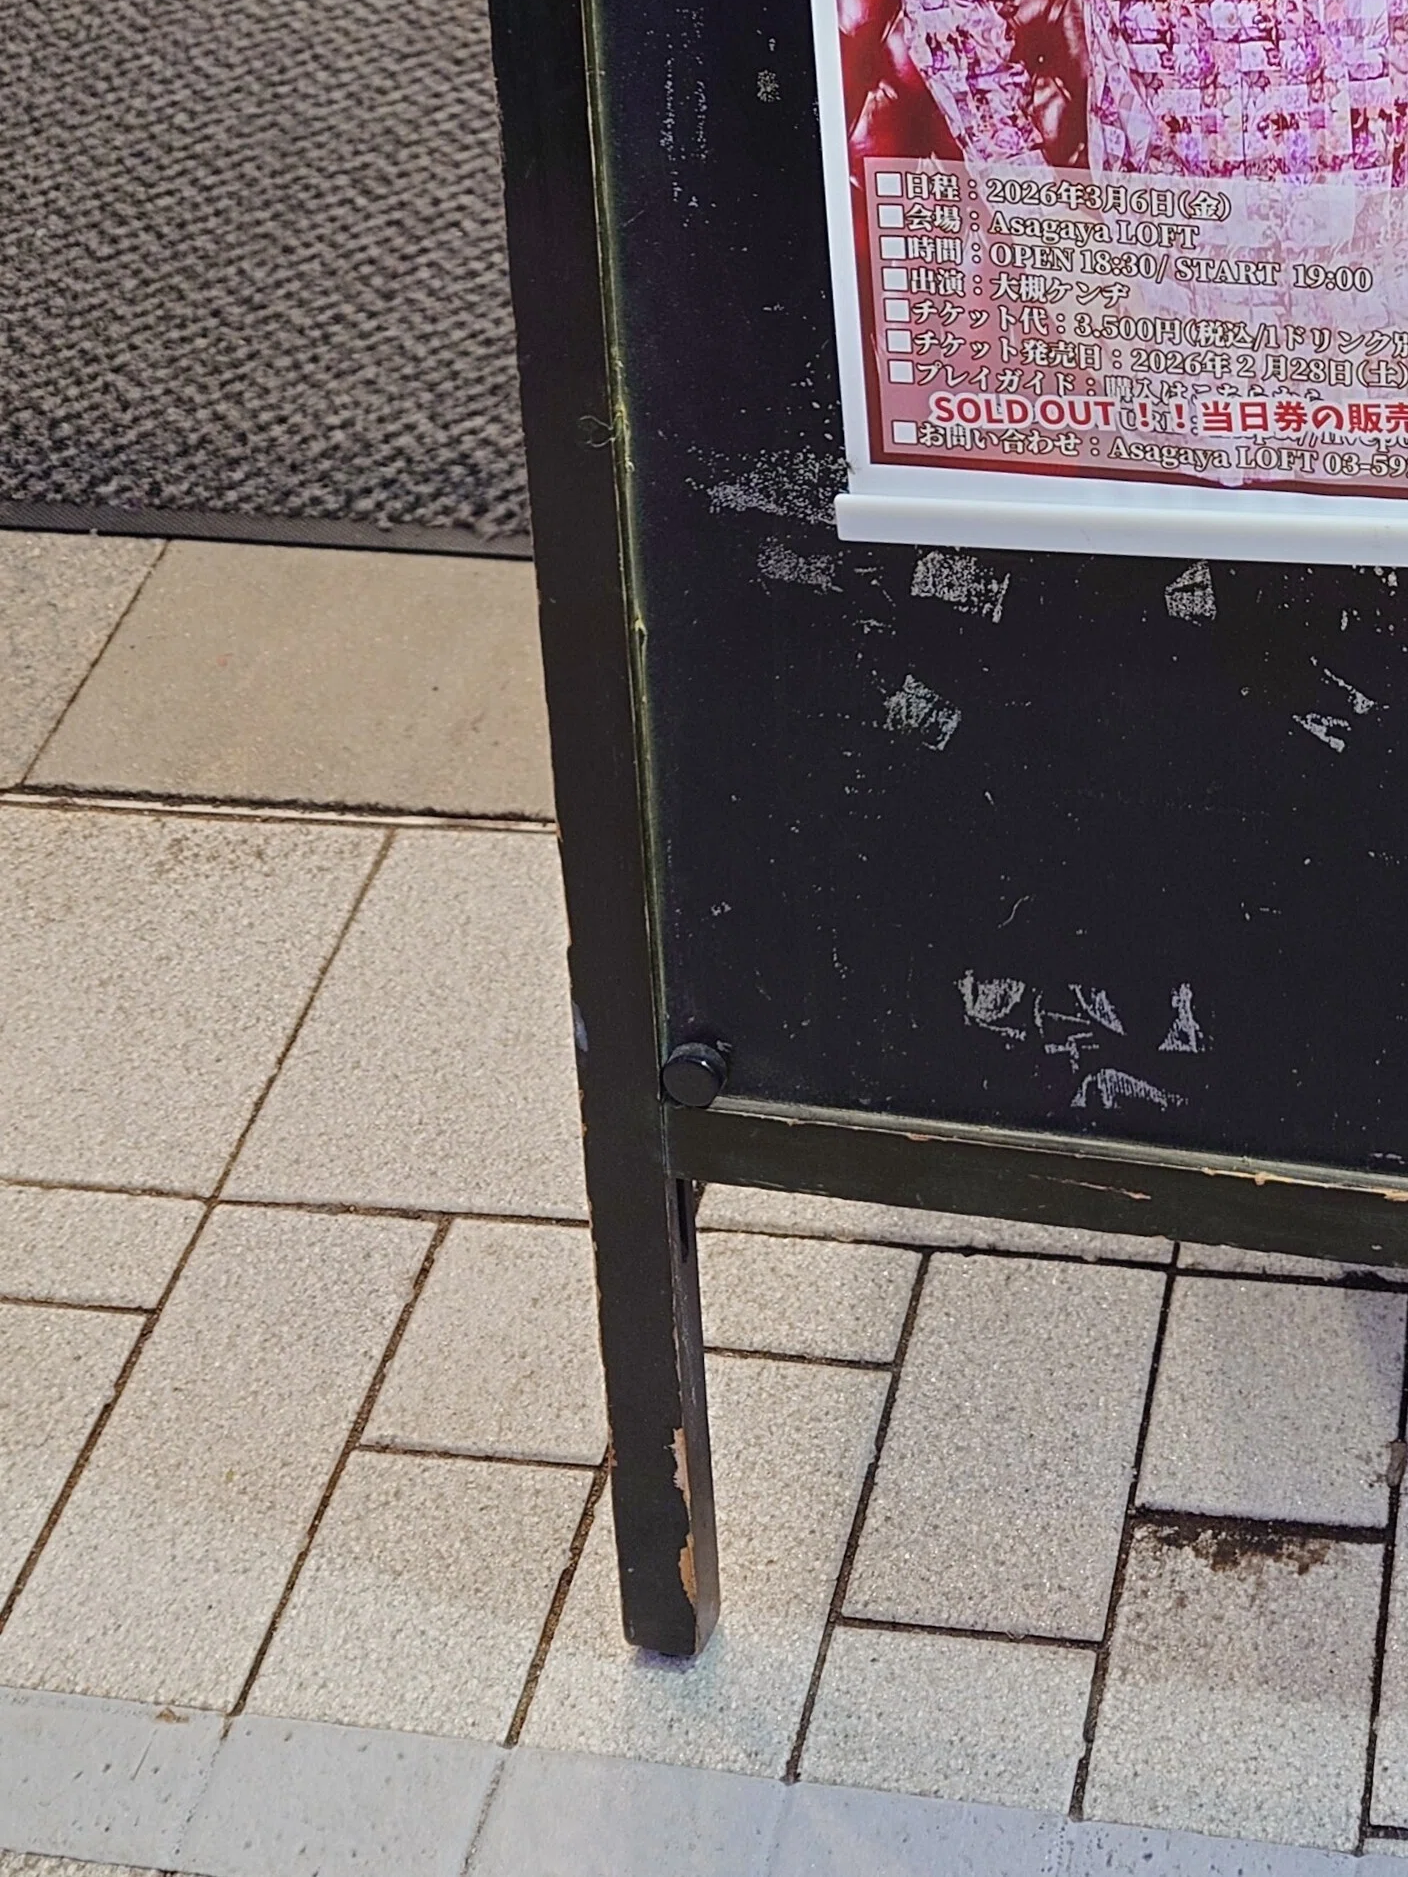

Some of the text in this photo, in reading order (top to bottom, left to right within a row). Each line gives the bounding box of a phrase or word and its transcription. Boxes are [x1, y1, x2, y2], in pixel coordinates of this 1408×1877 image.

[1117, 219, 1200, 250] LOFT
[1174, 256, 1281, 286] START
[1293, 262, 1374, 292] 19:00
[933, 395, 1029, 425] SOLD
[1236, 446, 1319, 473] LOFT
